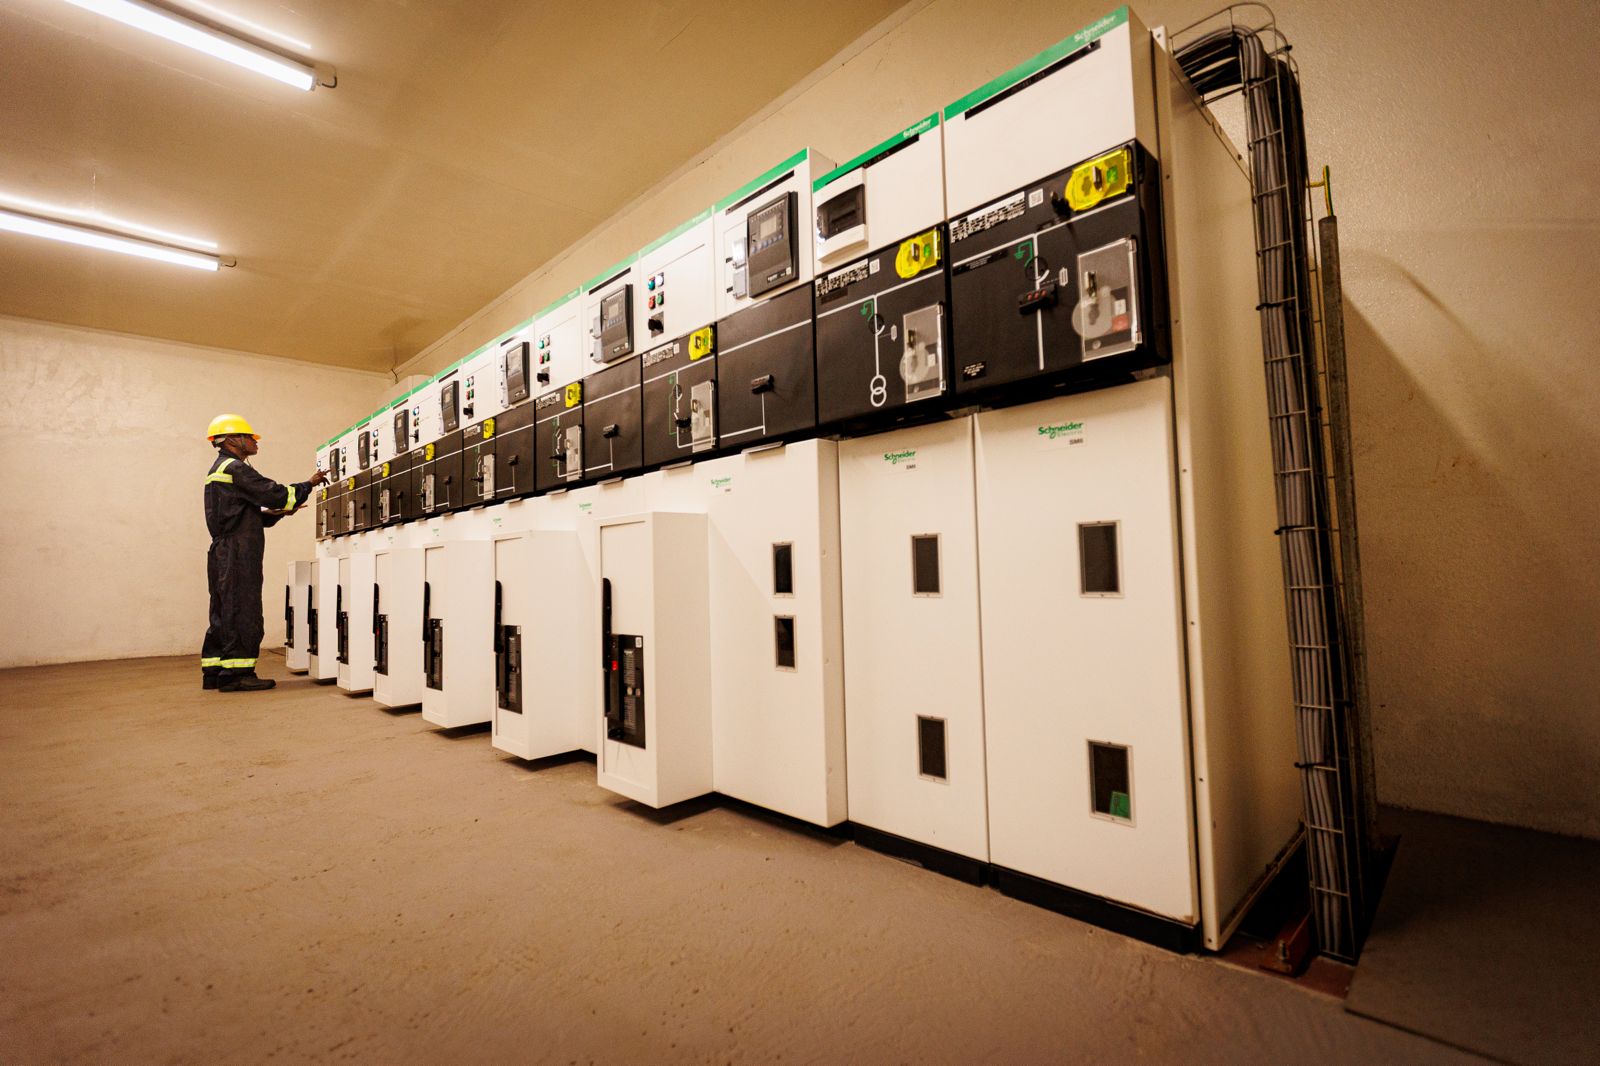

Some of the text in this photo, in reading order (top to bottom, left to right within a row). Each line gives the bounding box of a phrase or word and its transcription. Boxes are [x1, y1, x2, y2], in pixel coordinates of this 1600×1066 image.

[1074, 15, 1116, 42] Schneider
[1038, 422, 1084, 439] Schneider
[884, 450, 916, 464] Schneider
